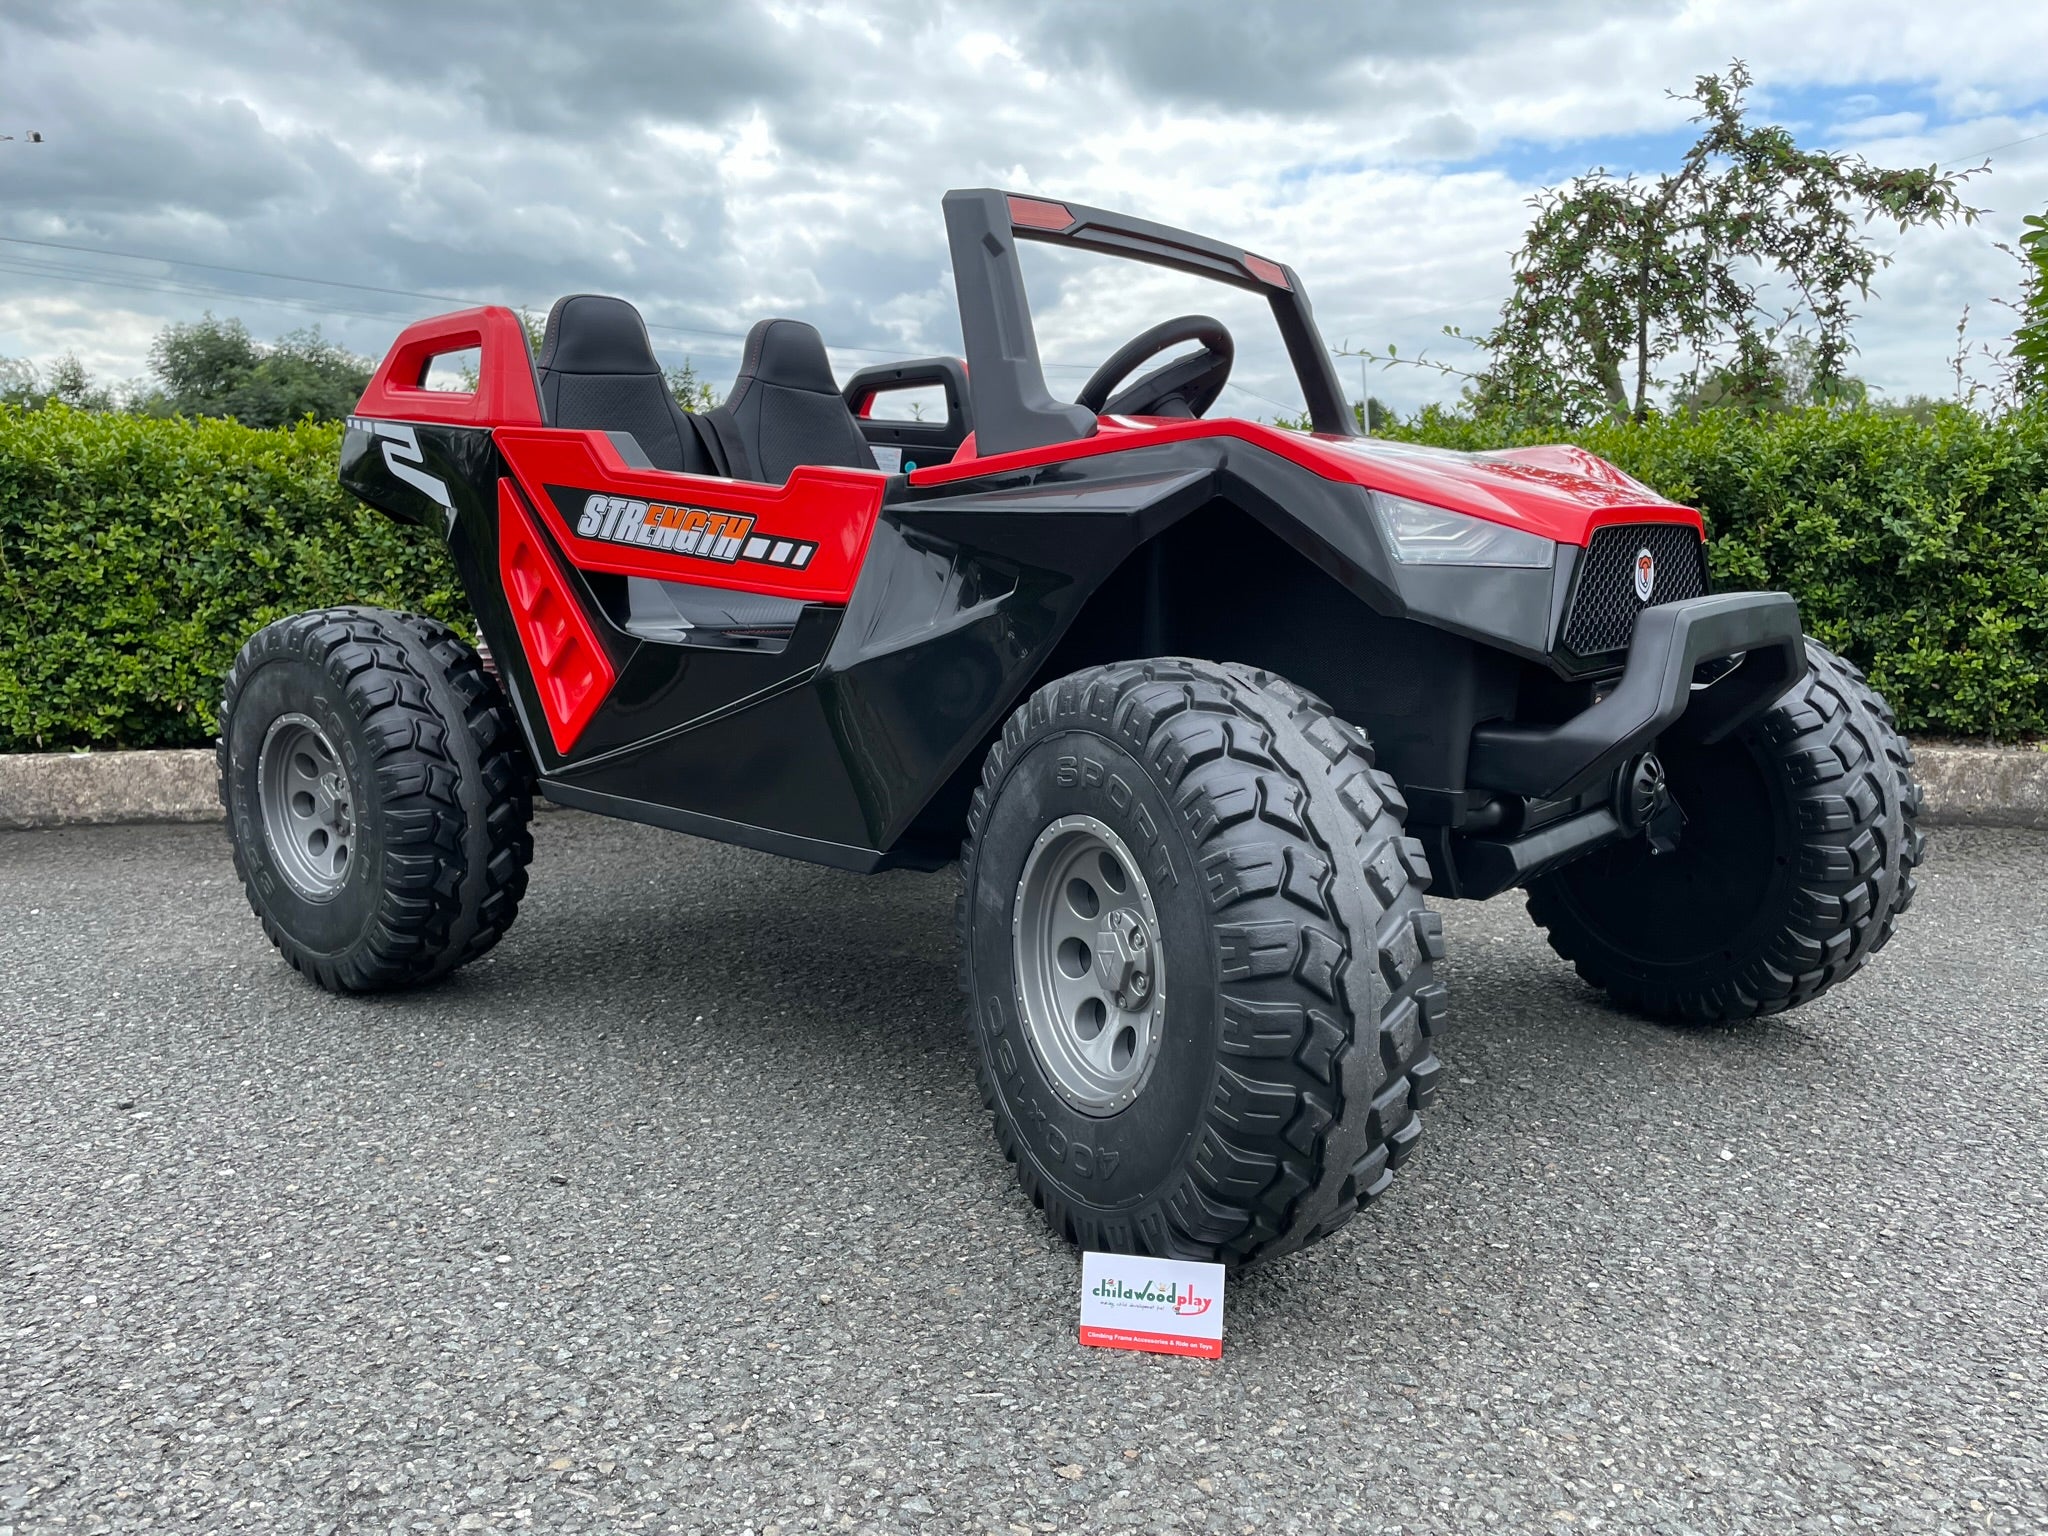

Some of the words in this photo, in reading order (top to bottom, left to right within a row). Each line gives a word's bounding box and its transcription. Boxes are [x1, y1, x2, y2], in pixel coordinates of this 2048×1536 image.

[577, 494, 755, 561] STRENGTH
[1056, 755, 1179, 888] SPORT
[1092, 1278, 1212, 1315] childwoodplay
[1087, 1331, 1113, 1341] Climbing
[1114, 1334, 1132, 1342] Frame
[1133, 1336, 1168, 1346] Accessories
[1175, 1340, 1188, 1348] Ride
[1199, 1343, 1213, 1351] Toys
